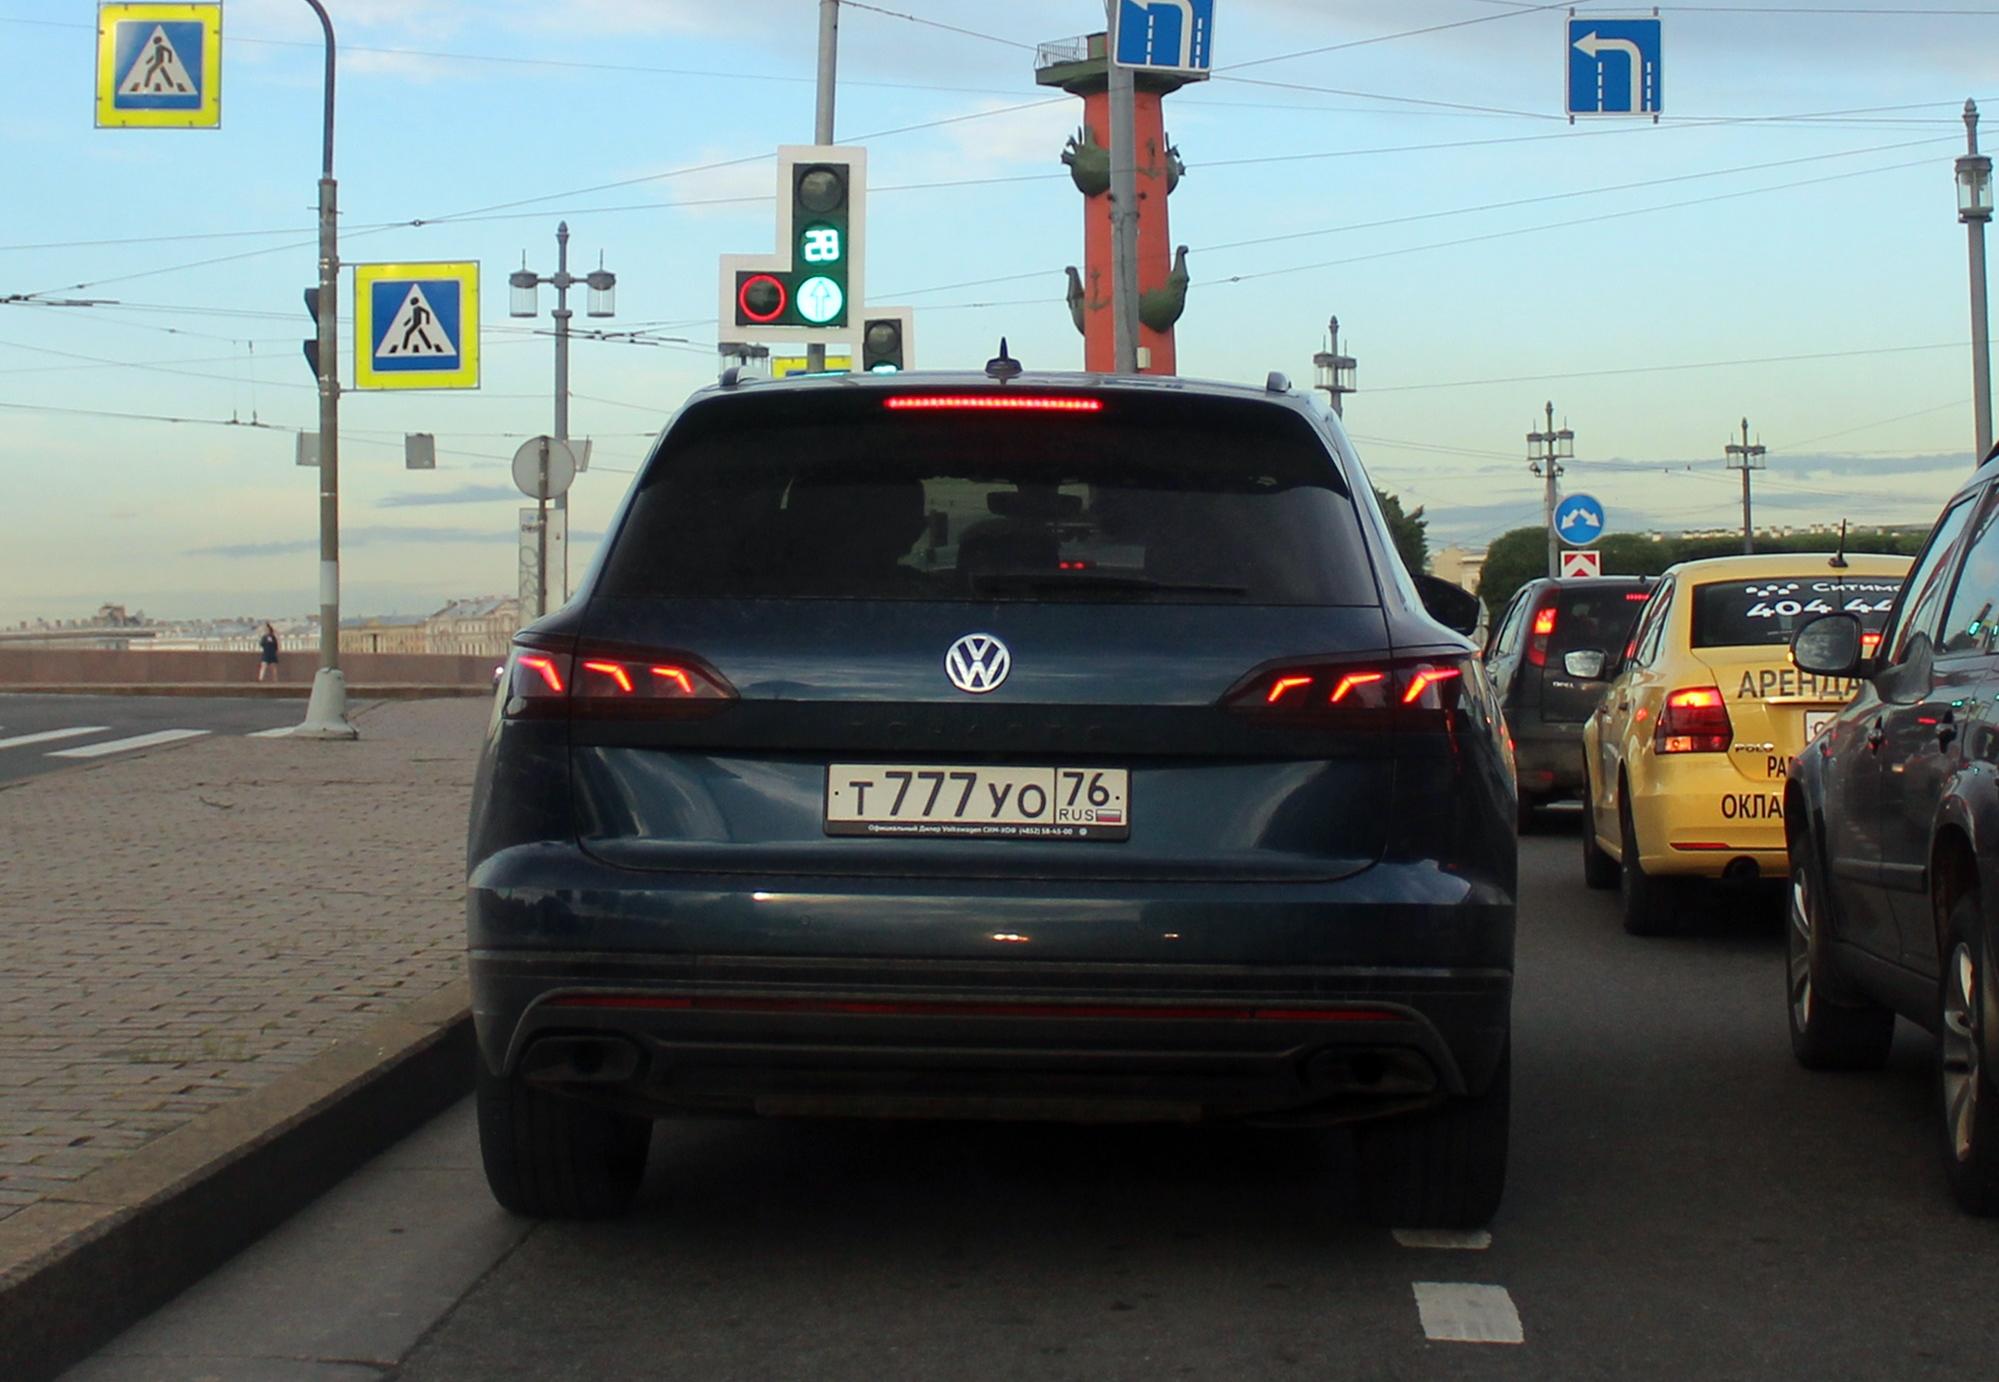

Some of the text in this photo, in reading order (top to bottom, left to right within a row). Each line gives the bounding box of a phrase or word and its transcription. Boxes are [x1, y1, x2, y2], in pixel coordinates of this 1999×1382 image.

[805, 229, 839, 261] 28
[1746, 598, 1832, 618] 404
[1737, 669, 1860, 700] АРЕНДА
[1734, 742, 1774, 753] POLO
[1767, 756, 1793, 778] РА
[1062, 772, 1110, 806] 76
[1058, 809, 1094, 822] RUS
